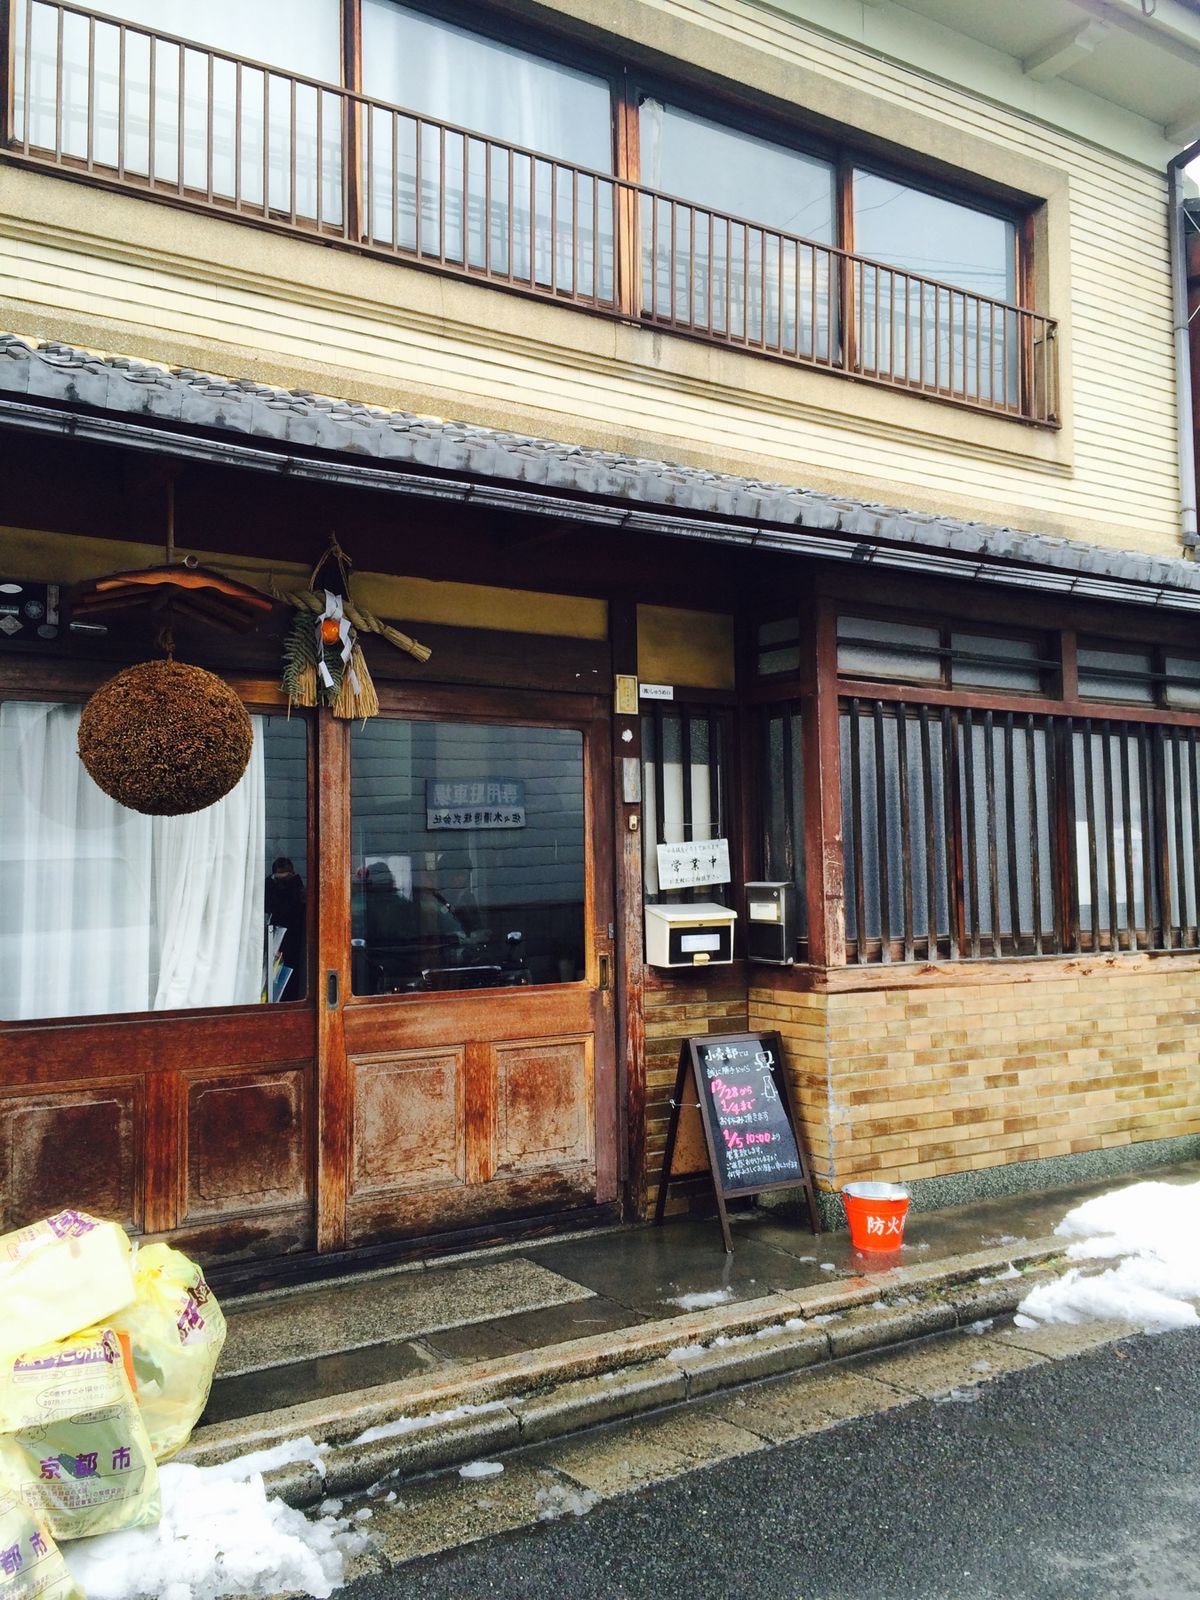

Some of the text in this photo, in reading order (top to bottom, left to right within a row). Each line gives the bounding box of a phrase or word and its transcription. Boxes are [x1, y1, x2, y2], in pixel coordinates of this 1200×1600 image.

[671, 855, 717, 872] 営業中
[39, 1445, 132, 1479] 京都市
